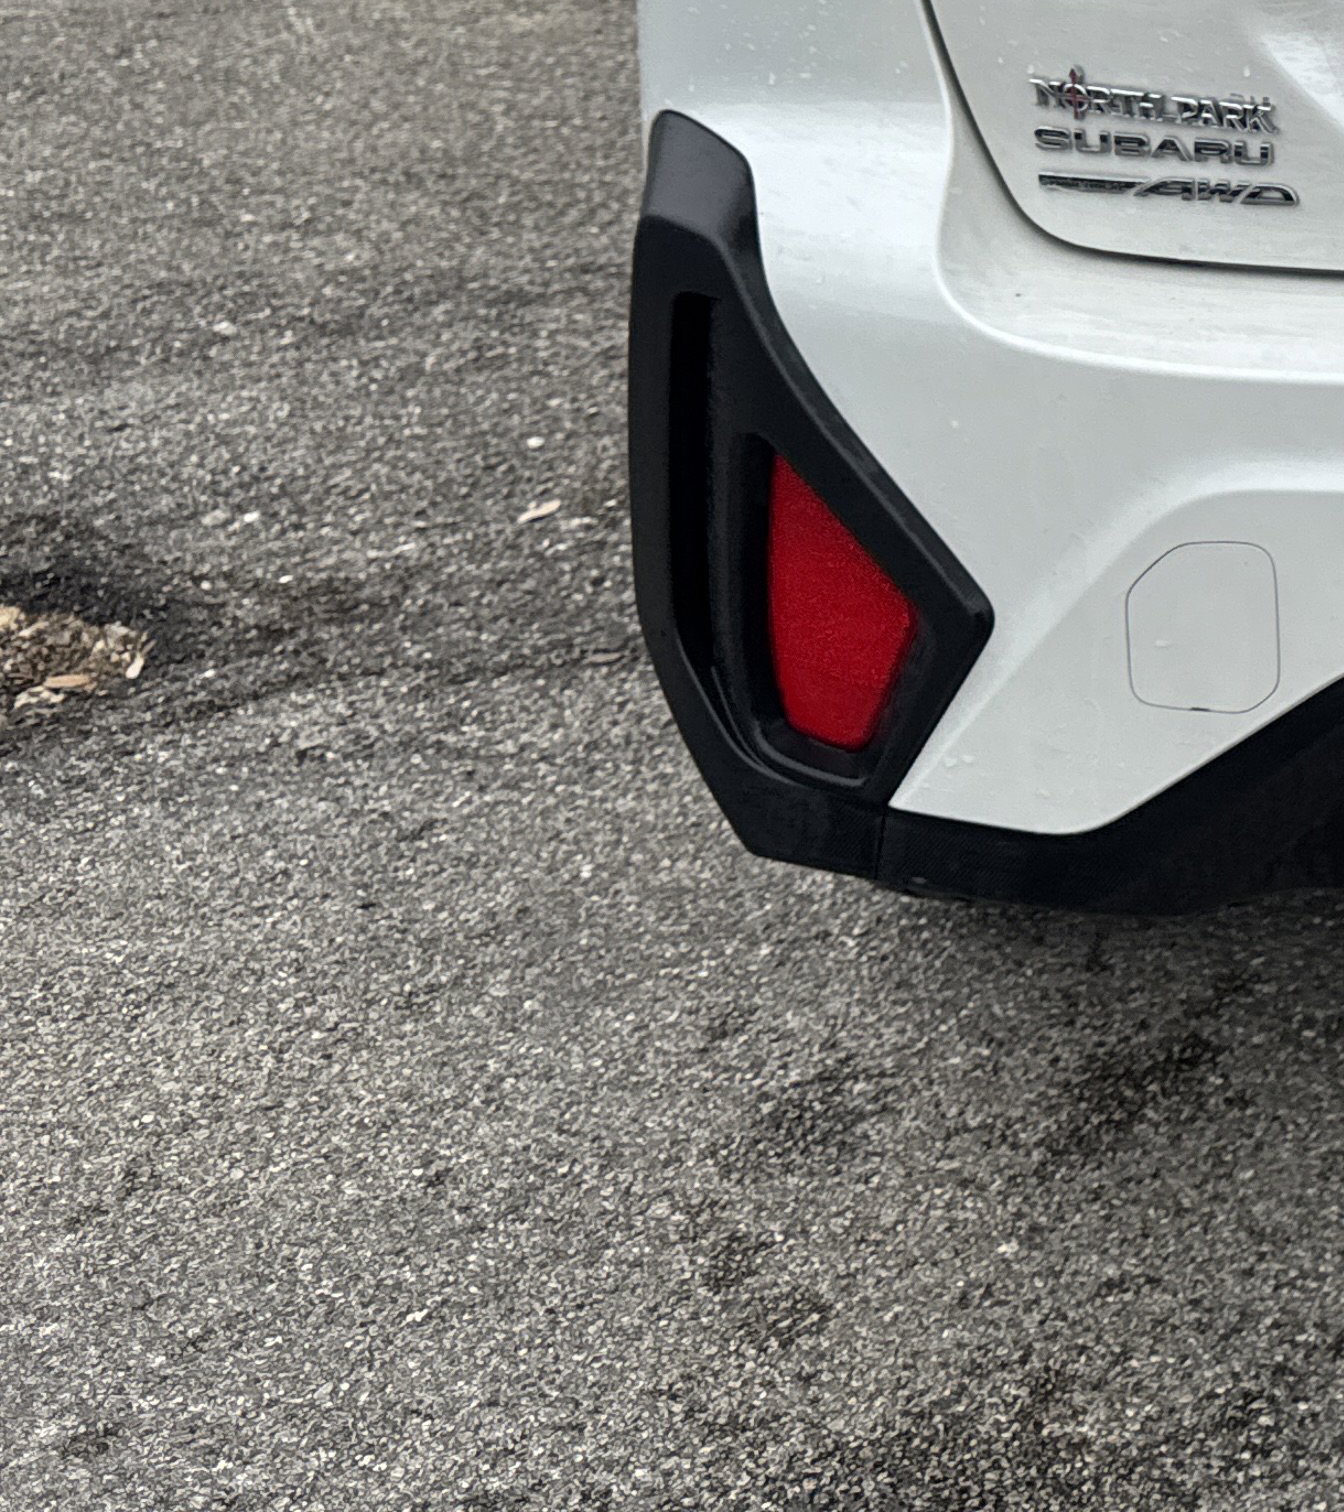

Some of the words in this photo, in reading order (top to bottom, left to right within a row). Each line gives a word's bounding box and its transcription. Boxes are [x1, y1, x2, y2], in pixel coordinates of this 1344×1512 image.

[1028, 74, 1166, 122] NORTH
[1171, 92, 1280, 134] PARK
[1033, 125, 1276, 167] SUBARU
[1133, 175, 1300, 207] AWD
